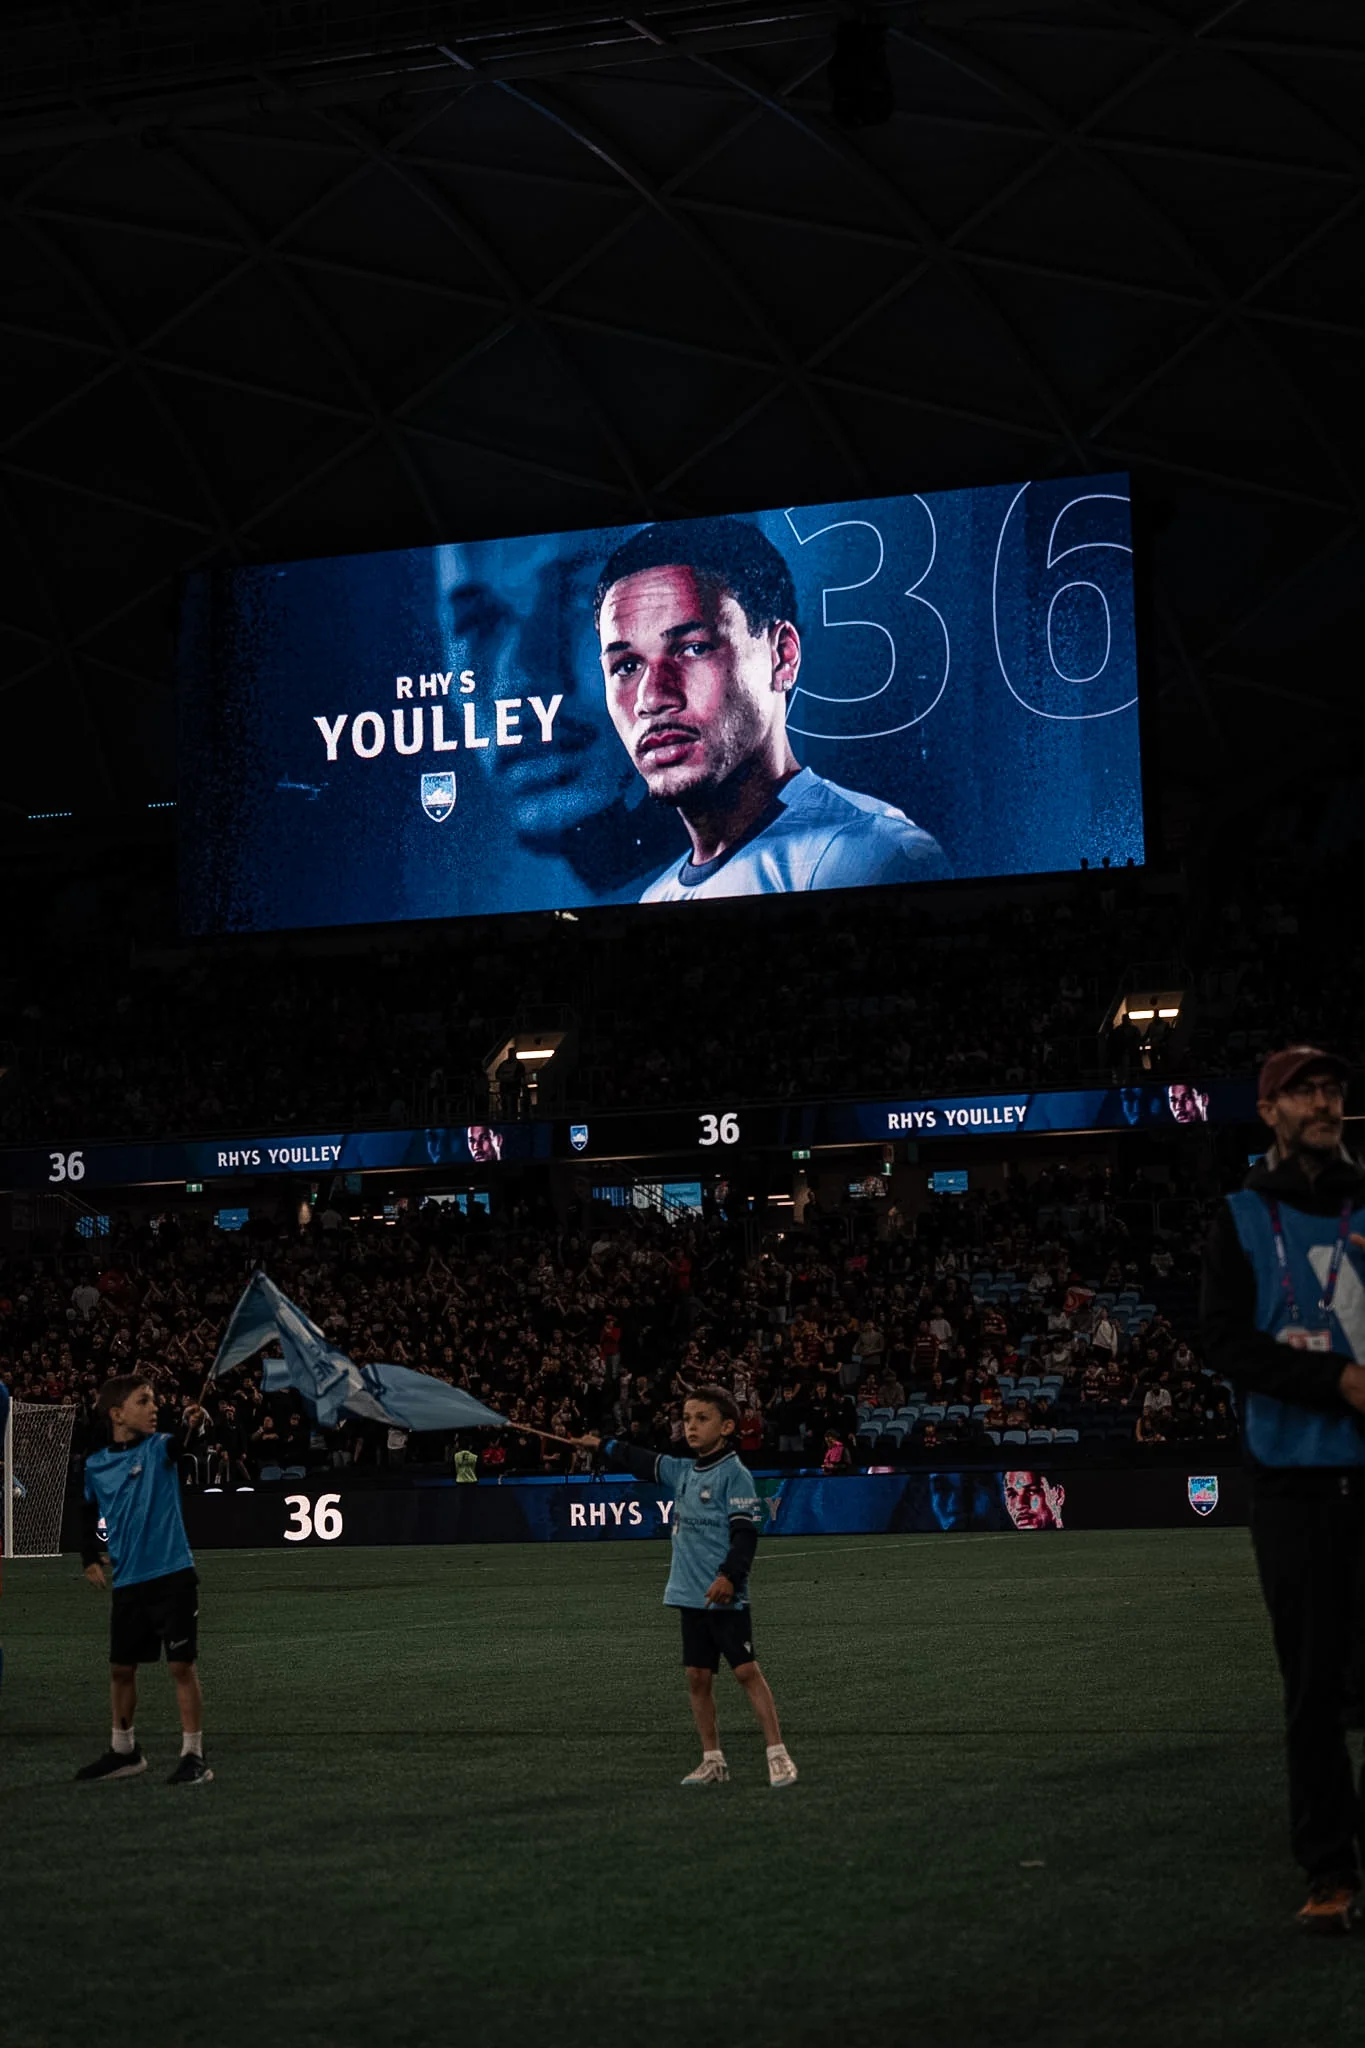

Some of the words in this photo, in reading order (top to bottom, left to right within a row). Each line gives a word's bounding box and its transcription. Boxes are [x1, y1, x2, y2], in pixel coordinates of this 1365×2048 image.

[784, 481, 1139, 740] 36
[396, 670, 476, 699] RHYS
[313, 694, 564, 761] YOULLEY
[698, 1112, 740, 1146] 36
[887, 1110, 936, 1130] RHYS
[943, 1105, 1027, 1127] YOULLEY
[48, 1151, 86, 1182] 36
[217, 1150, 261, 1167] RHYS
[267, 1145, 342, 1164] YOULLEY
[283, 1493, 343, 1541] 36
[570, 1501, 643, 1527] RHYS
